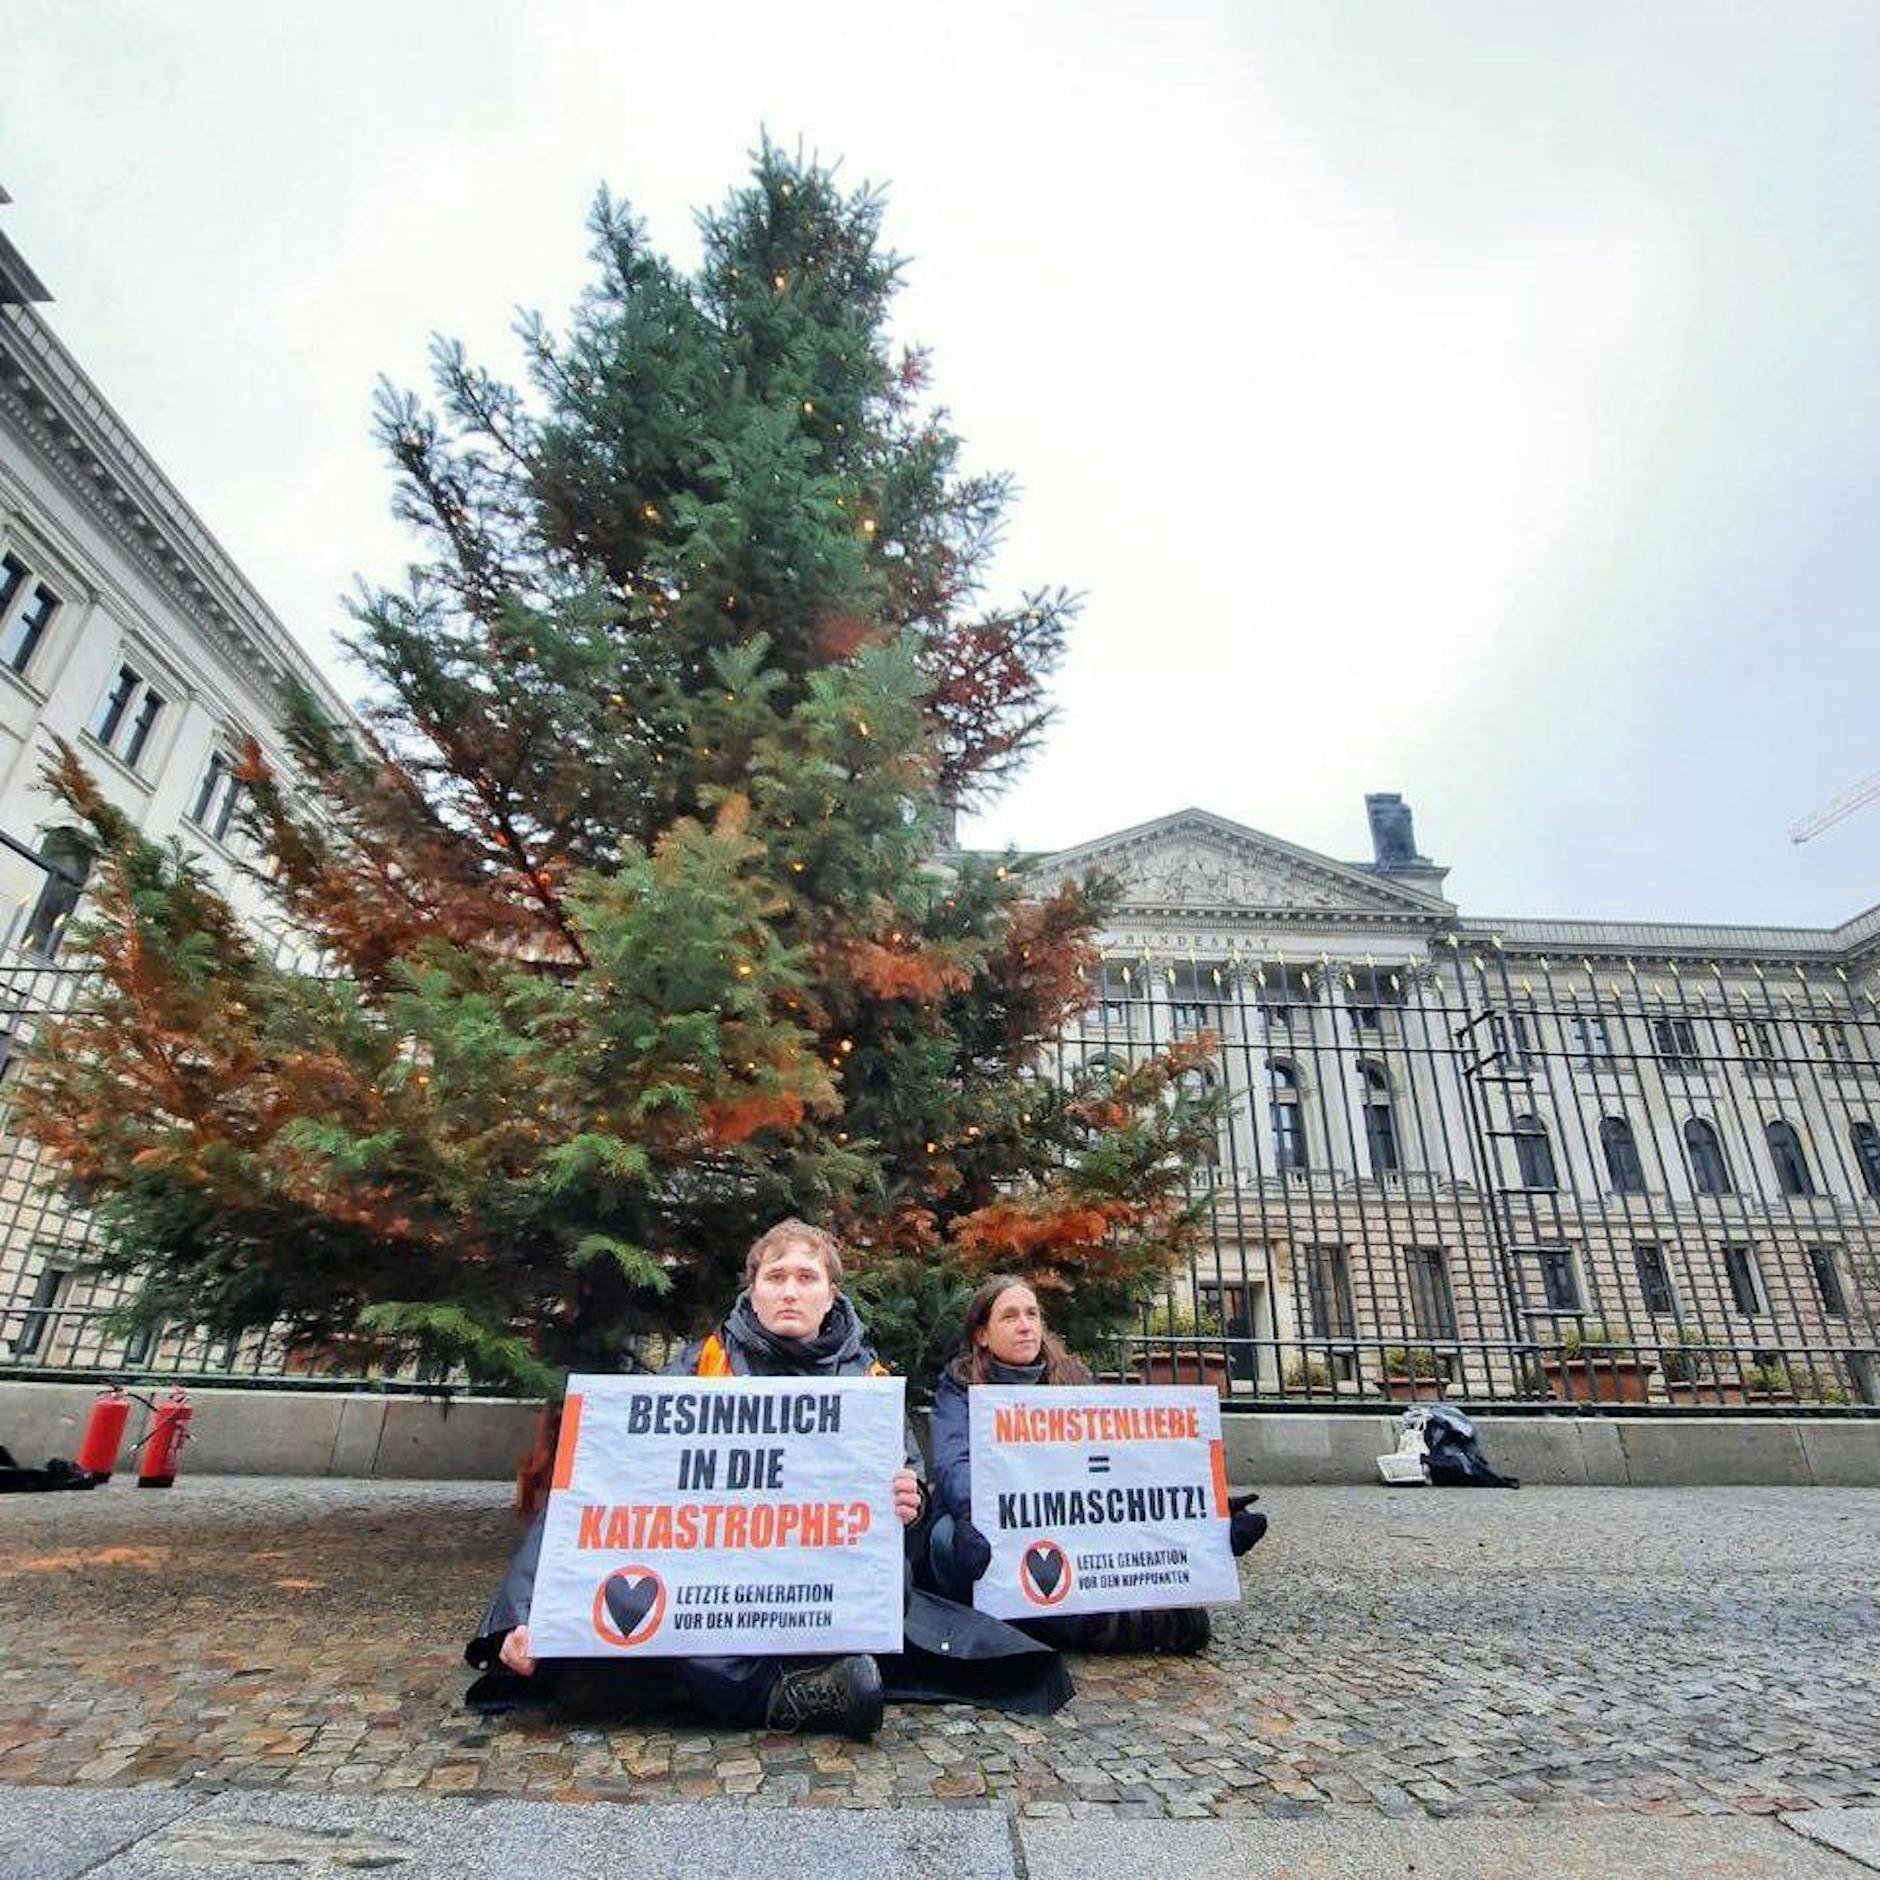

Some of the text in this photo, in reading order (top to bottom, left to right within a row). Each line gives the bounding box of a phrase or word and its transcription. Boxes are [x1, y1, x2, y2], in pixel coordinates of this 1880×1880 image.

[1125, 934, 1270, 949] BUNDESRAT
[627, 1394, 841, 1434] BESINNLICH
[994, 1403, 1200, 1443] NÄCHSTENLIEBE
[678, 1449, 784, 1490] IN DIE
[999, 1486, 1207, 1529] KLIMASCHUTZ!
[578, 1501, 871, 1550] KATASTROPHE?
[1077, 1549, 1188, 1571] LETZTE GENERATION
[676, 1583, 833, 1605] LETZTE GENERATION
[1078, 1570, 1190, 1590] VOR DEN KIPPPUNKTEN
[674, 1610, 832, 1630] VOR DEN KIPPPUNKTEN
